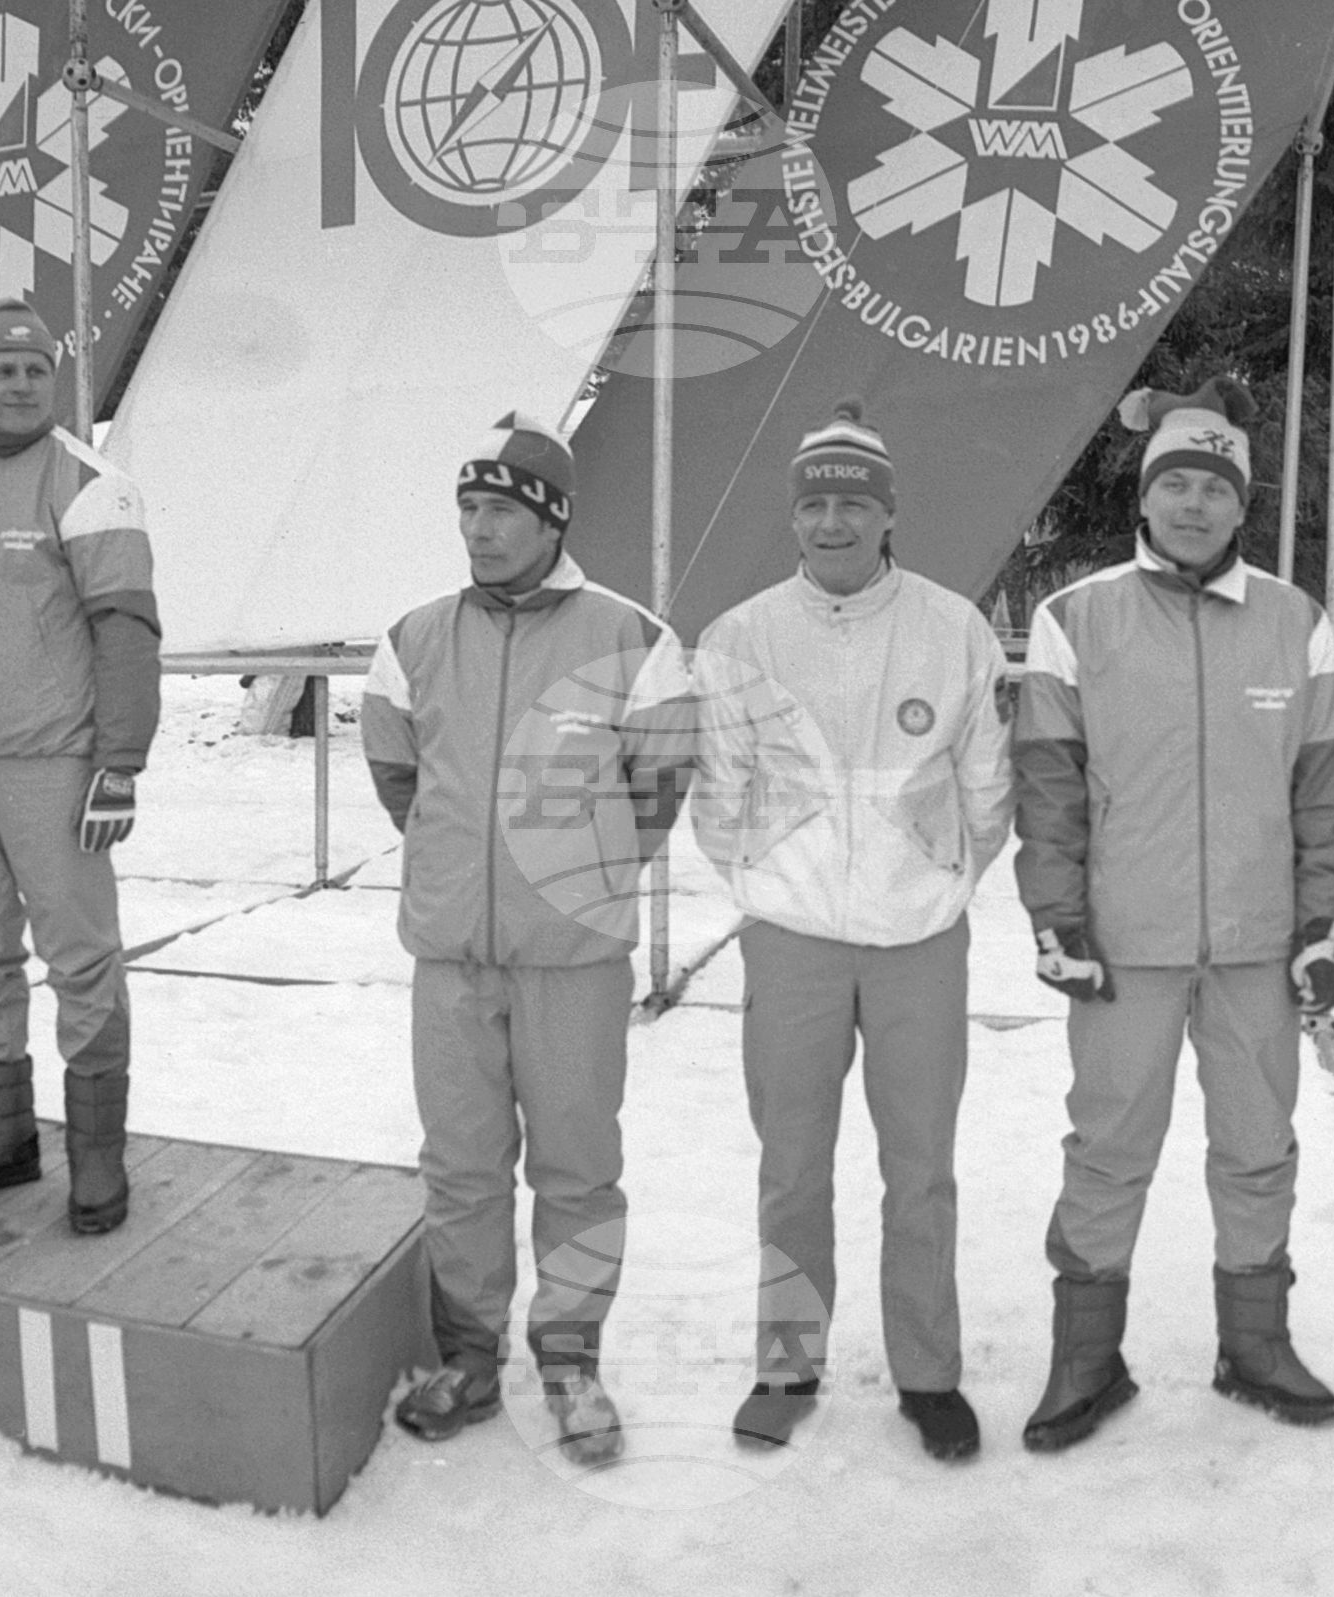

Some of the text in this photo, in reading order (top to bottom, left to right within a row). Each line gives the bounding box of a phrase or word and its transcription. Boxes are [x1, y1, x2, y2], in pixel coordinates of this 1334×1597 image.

[968, 118, 1068, 161] WM
[781, 159, 857, 290] SECHSTE
[841, 280, 1047, 366] BULGARIEN
[1051, 301, 1139, 358] 1986
[804, 463, 870, 480] SVERIGE
